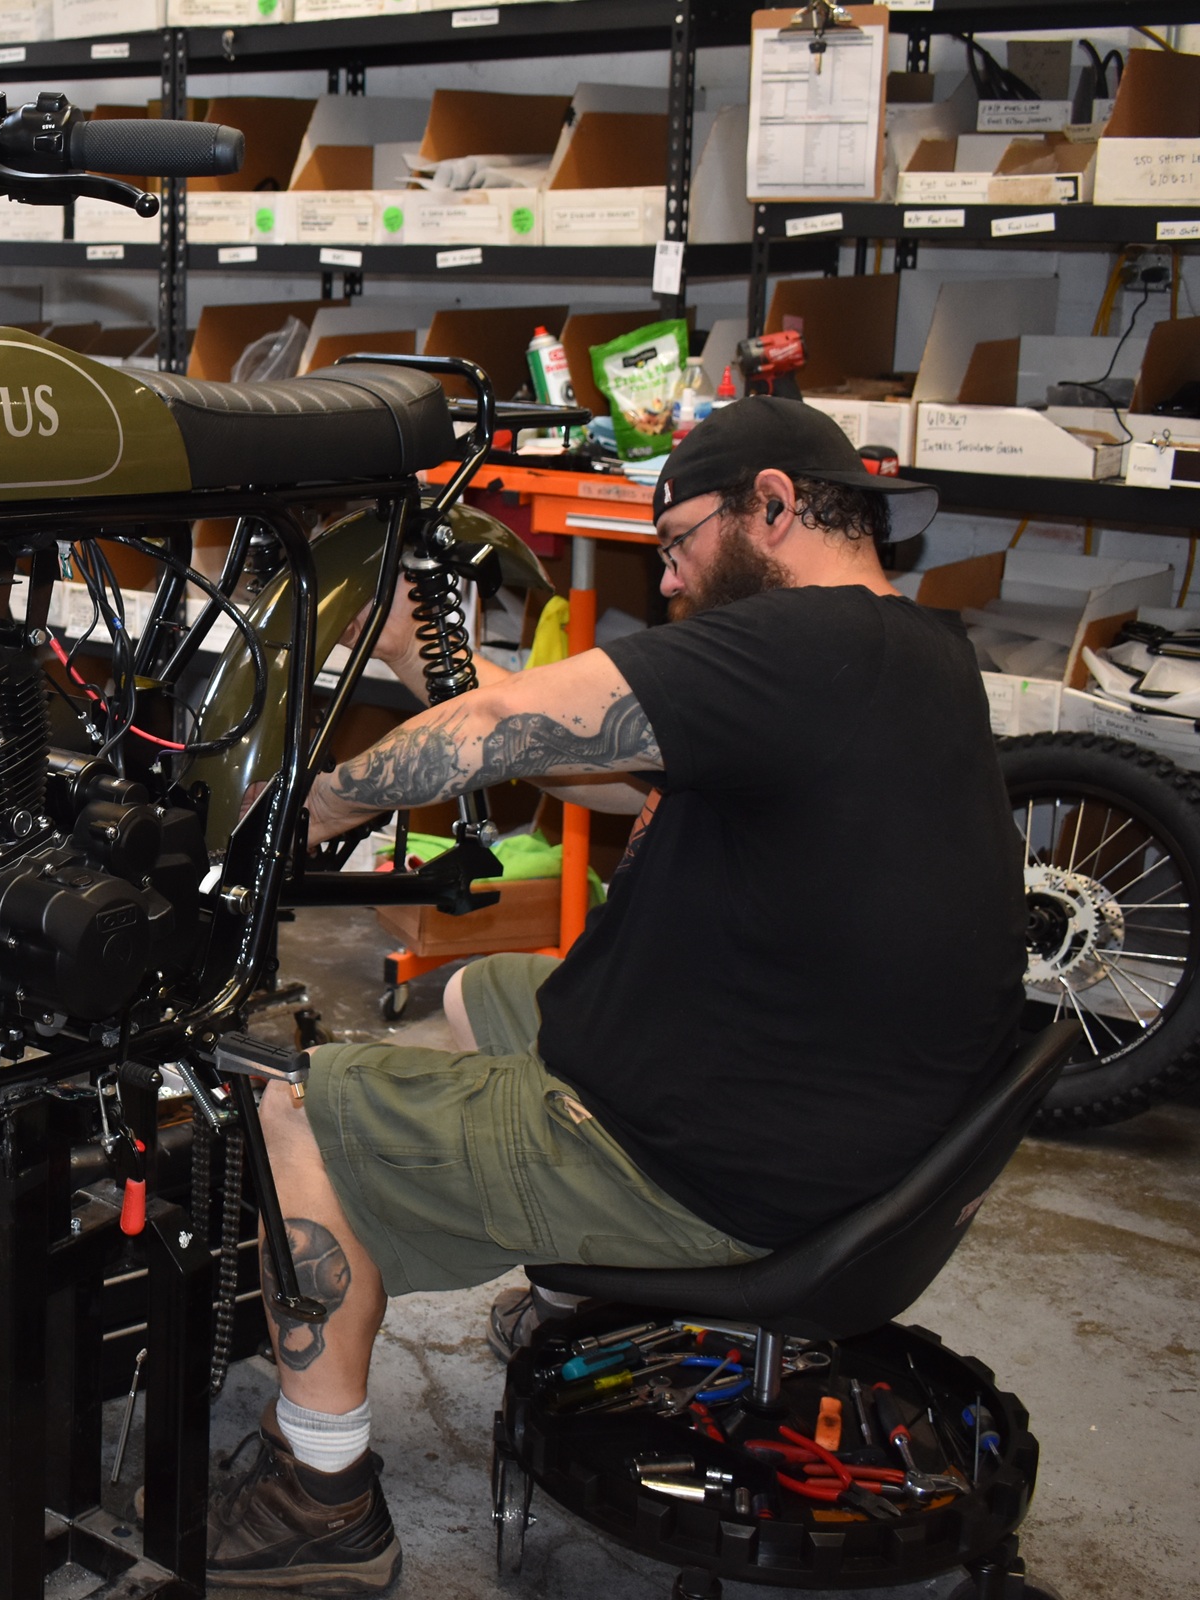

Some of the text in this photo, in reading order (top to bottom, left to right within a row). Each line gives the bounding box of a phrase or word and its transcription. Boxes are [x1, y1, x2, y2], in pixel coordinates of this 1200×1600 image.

[1134, 156, 1152, 165] 250
[1159, 154, 1186, 165] SHIFT
[921, 438, 953, 453] Intake
